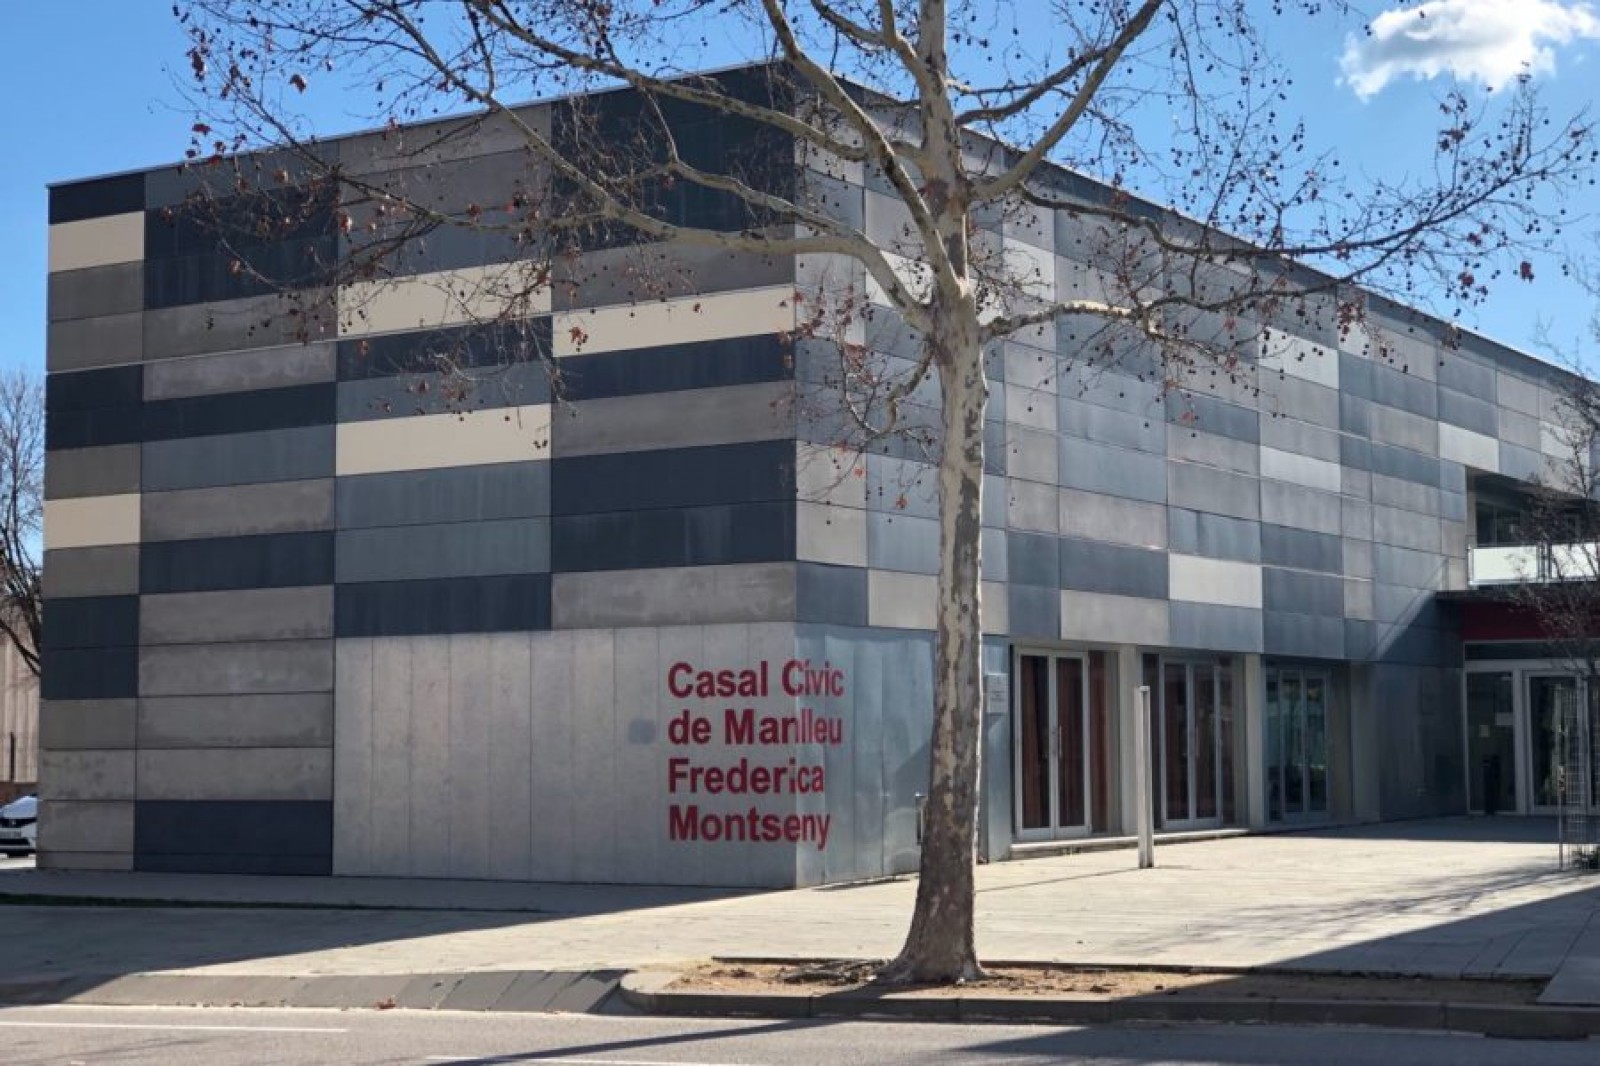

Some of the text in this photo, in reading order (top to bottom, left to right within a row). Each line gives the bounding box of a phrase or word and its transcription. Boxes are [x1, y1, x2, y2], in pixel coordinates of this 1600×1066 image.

[668, 661, 769, 698] Casal
[668, 708, 842, 745] de Manlleu
[668, 757, 824, 794] Frederica
[669, 804, 831, 850] Montseny
